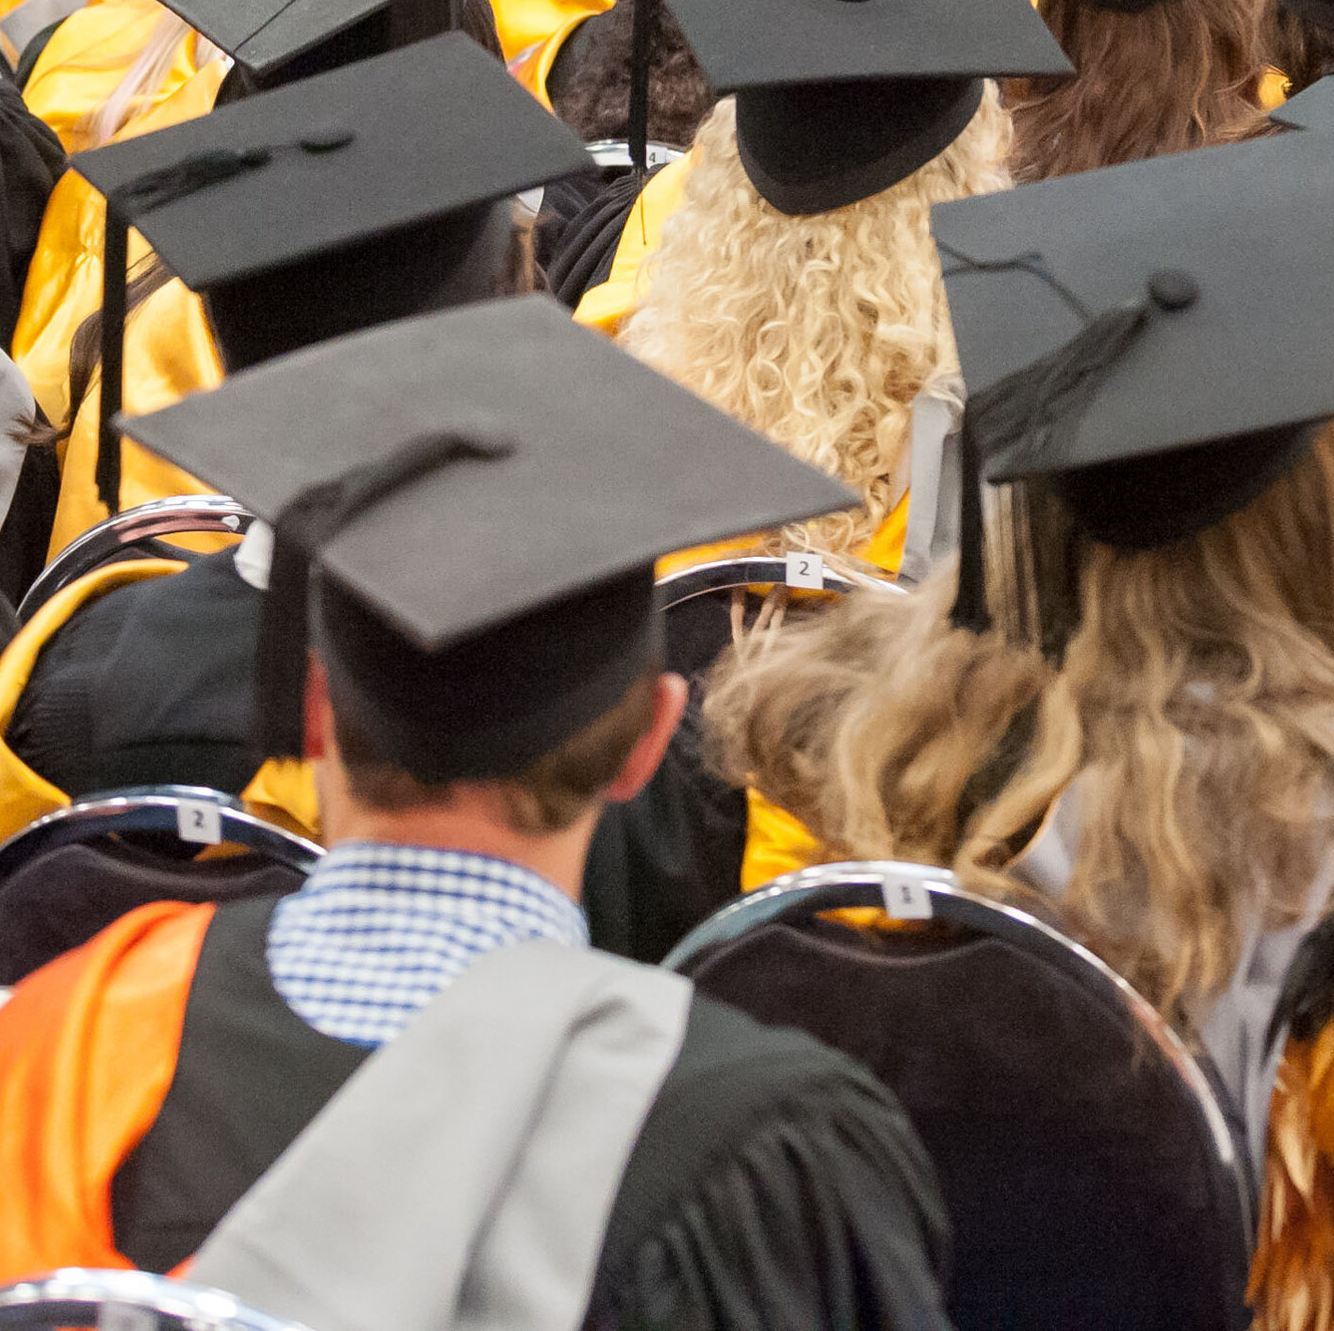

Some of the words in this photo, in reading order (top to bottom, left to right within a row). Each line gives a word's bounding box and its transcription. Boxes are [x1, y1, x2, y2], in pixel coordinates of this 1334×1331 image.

[648, 151, 656, 164] 4
[798, 560, 810, 576] 2
[192, 809, 205, 829] 2
